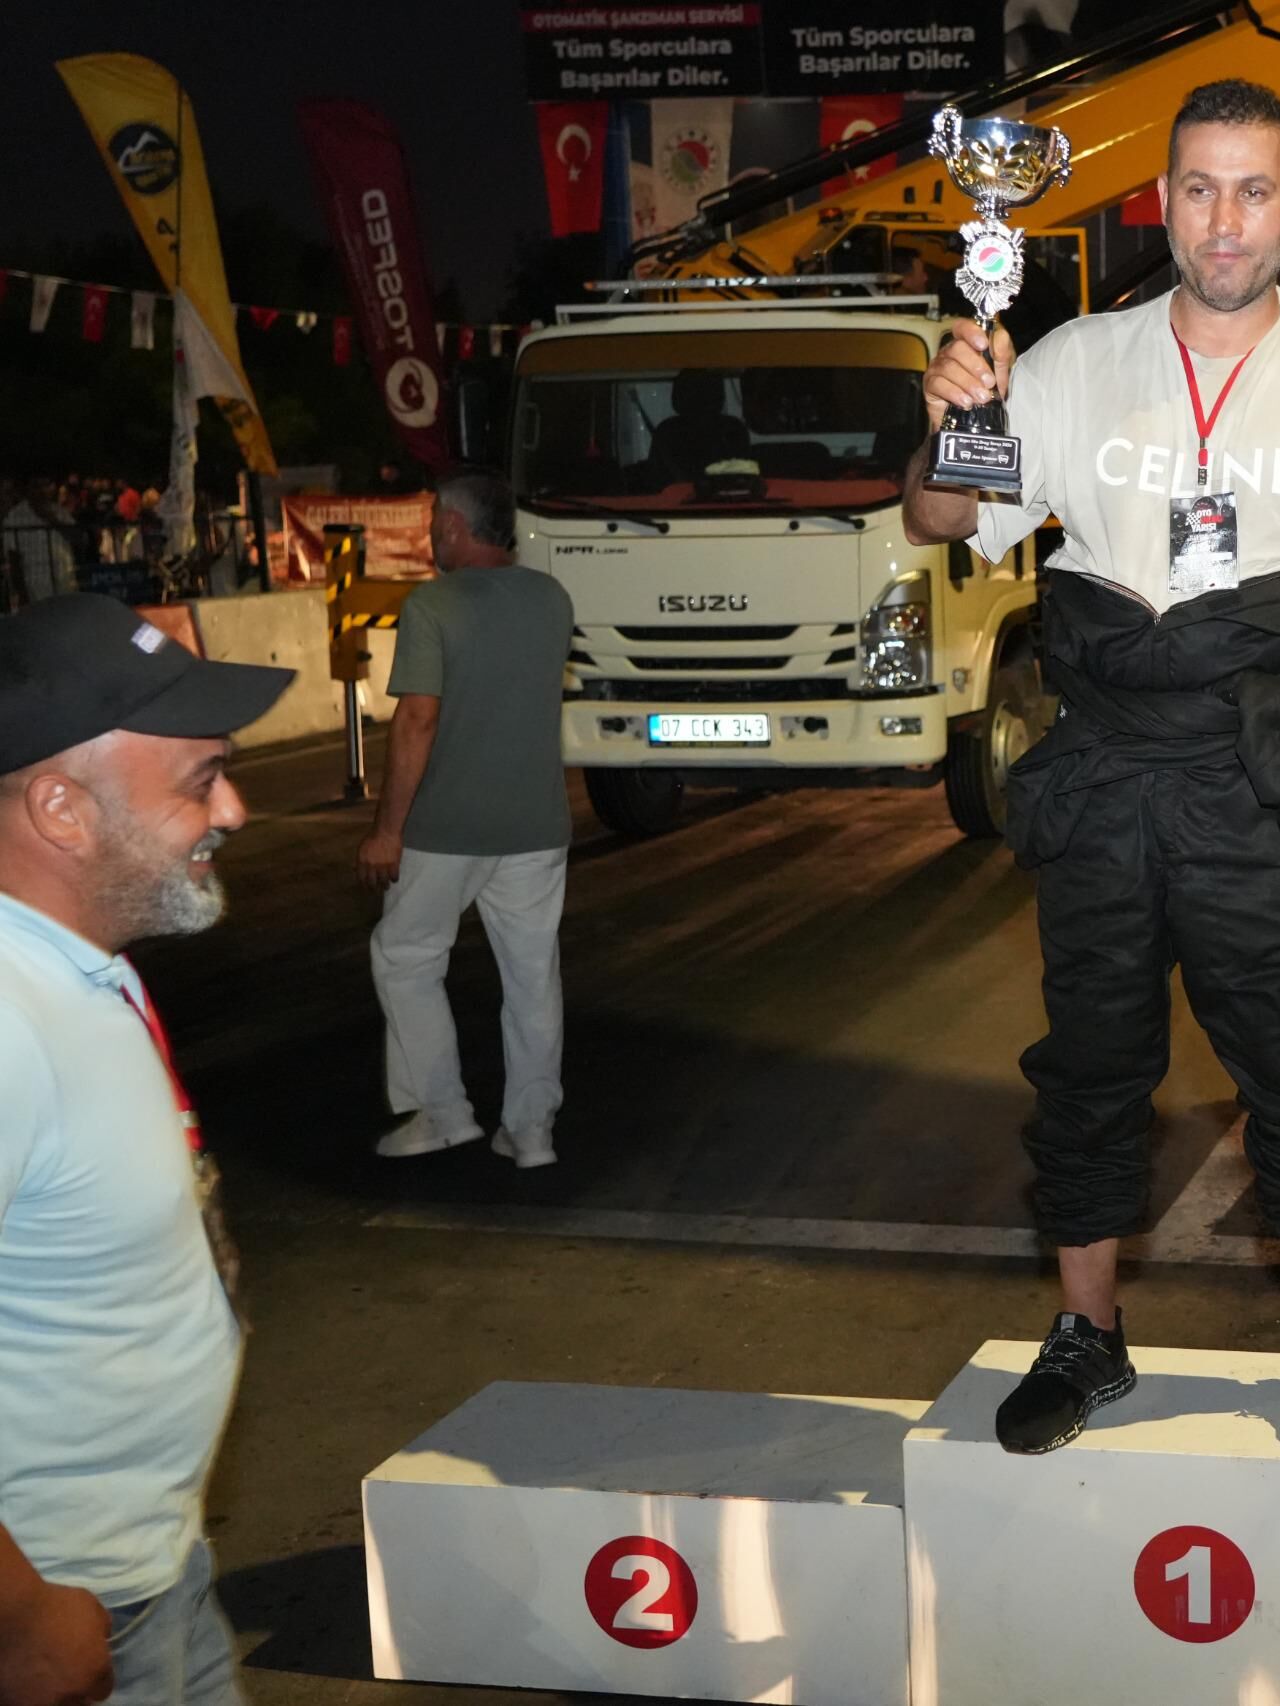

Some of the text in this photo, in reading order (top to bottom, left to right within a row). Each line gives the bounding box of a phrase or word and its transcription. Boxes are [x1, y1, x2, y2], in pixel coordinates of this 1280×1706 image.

[552, 37, 732, 60] Tüm Sporculara
[790, 24, 975, 51] Tüm Sporculara
[799, 49, 970, 78] Başarılar Diler.
[561, 65, 728, 93] Başarılar Diler.
[659, 595, 749, 612] ISUZU
[661, 719, 764, 737] 07 CCK 343
[610, 1554, 674, 1632] 2
[1165, 1545, 1211, 1625] 1
